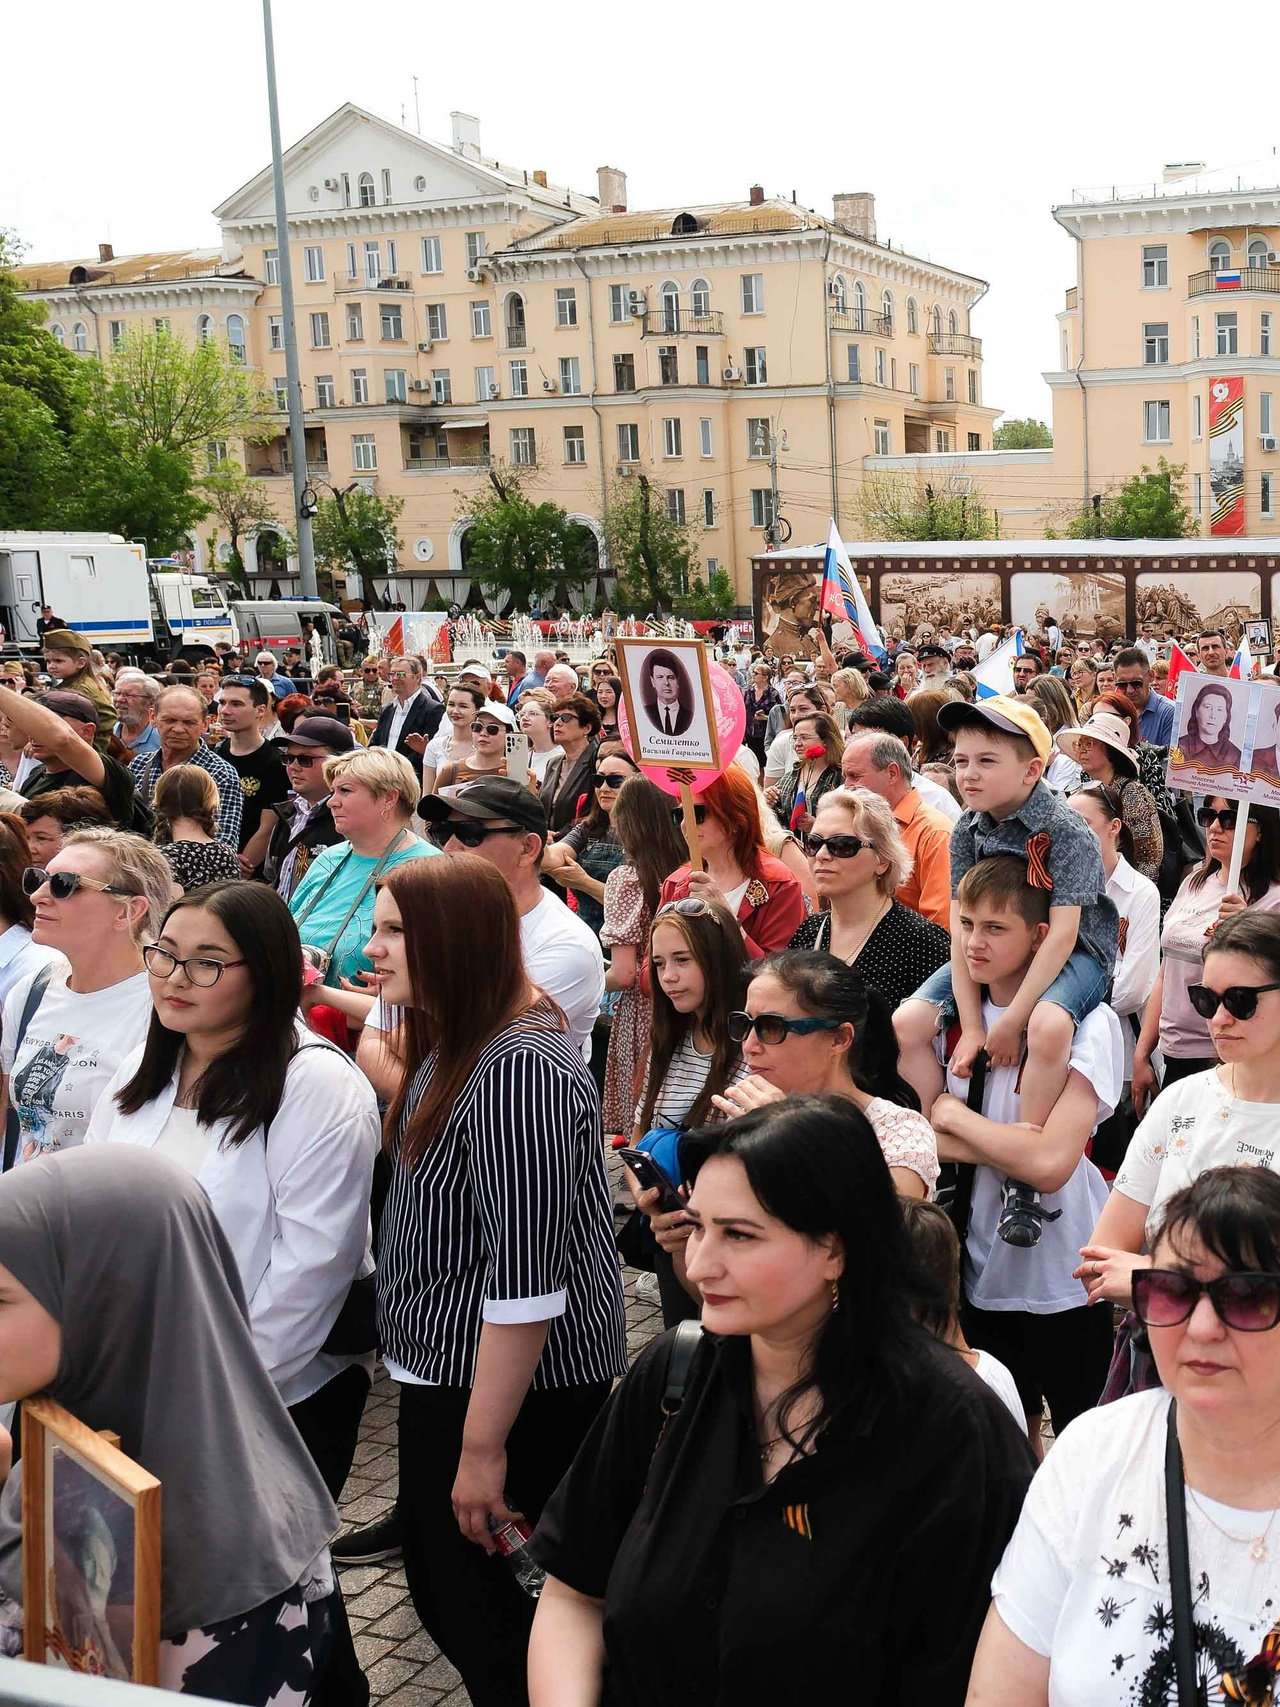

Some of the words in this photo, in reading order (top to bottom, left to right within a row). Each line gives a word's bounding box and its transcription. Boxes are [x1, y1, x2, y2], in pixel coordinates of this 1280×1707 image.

[203, 618, 230, 626] ПОЛИЦИЯ
[649, 735, 700, 747] Семилетко
[642, 746, 670, 755] Василий
[671, 748, 710, 758] Гаврилович
[52, 1110, 85, 1119] PARIS
